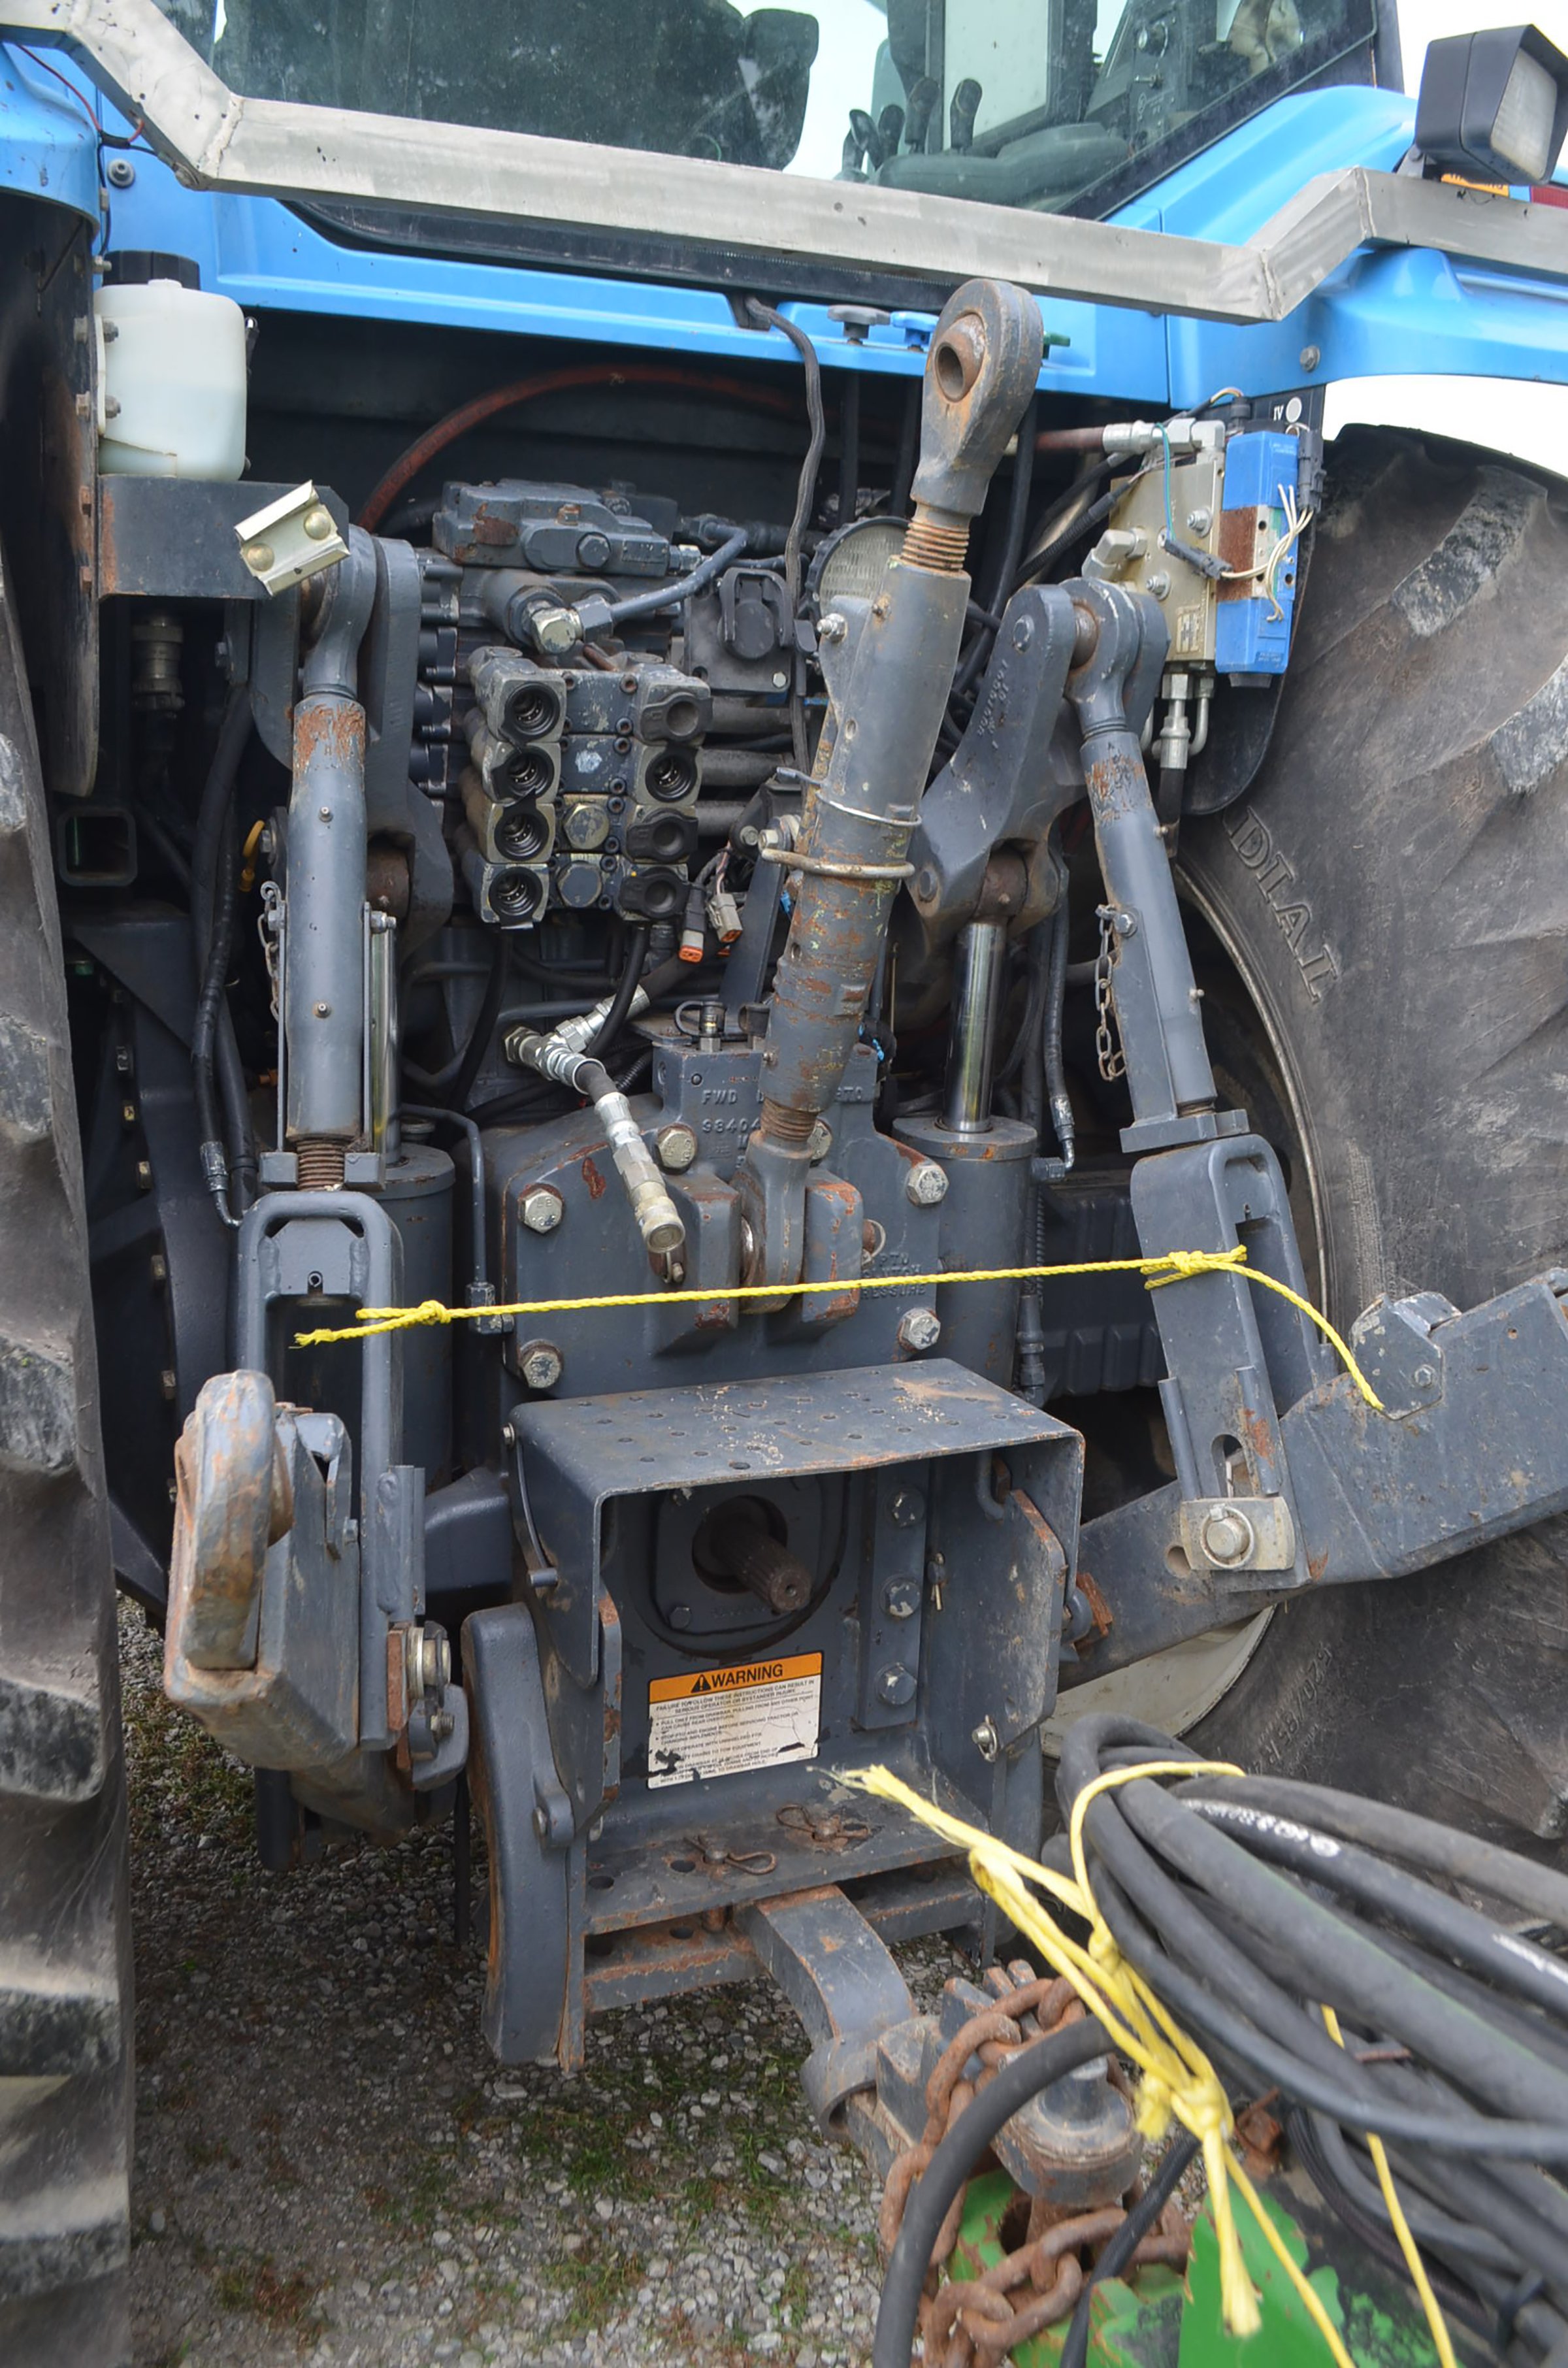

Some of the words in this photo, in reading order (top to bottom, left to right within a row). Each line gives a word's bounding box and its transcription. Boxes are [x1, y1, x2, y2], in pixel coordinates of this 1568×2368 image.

[1223, 805, 1341, 1005] DIAL
[702, 1089, 738, 1105] FWD
[702, 1118, 760, 1133] 98404
[860, 1283, 926, 1300] RESSURE
[711, 1664, 783, 1688] WARNING
